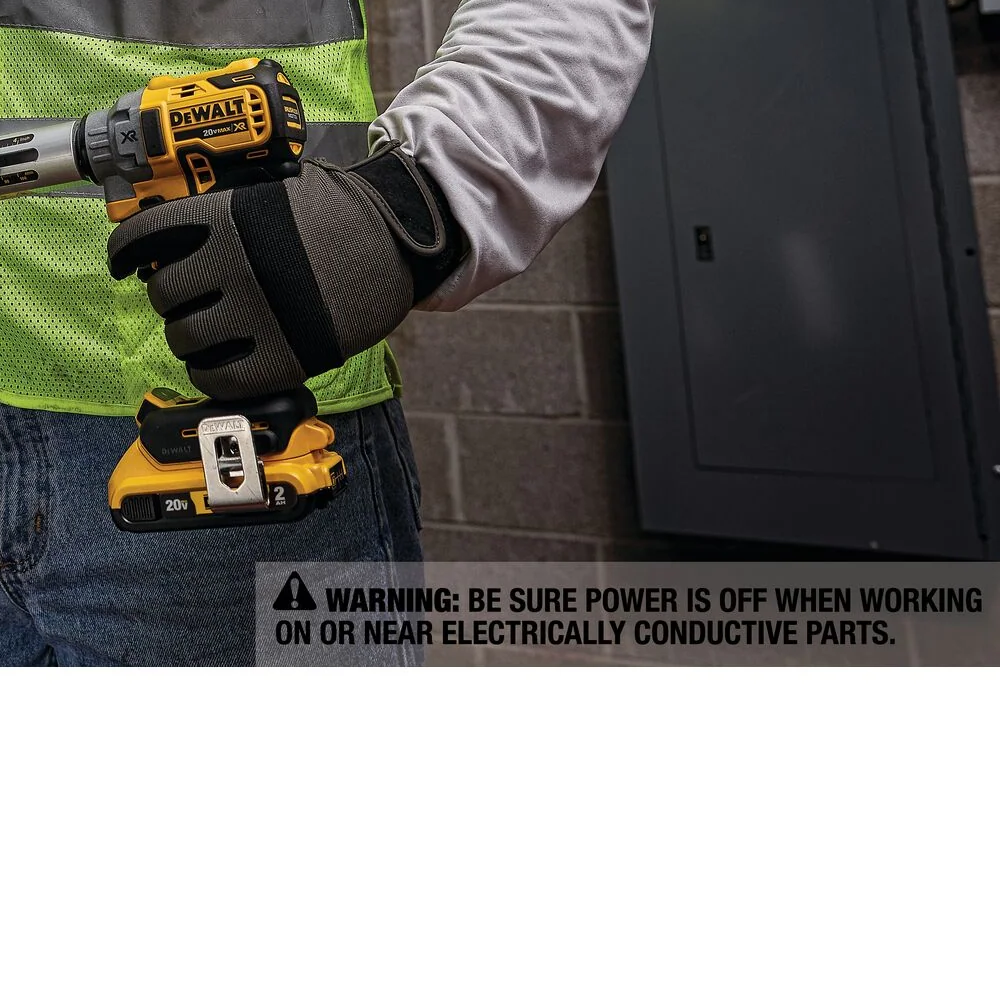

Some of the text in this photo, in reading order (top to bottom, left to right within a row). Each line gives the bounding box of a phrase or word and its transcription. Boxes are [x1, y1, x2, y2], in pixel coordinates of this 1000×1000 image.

[233, 122, 247, 132] XR
[120, 130, 138, 144] XR
[274, 486, 286, 500] 2
